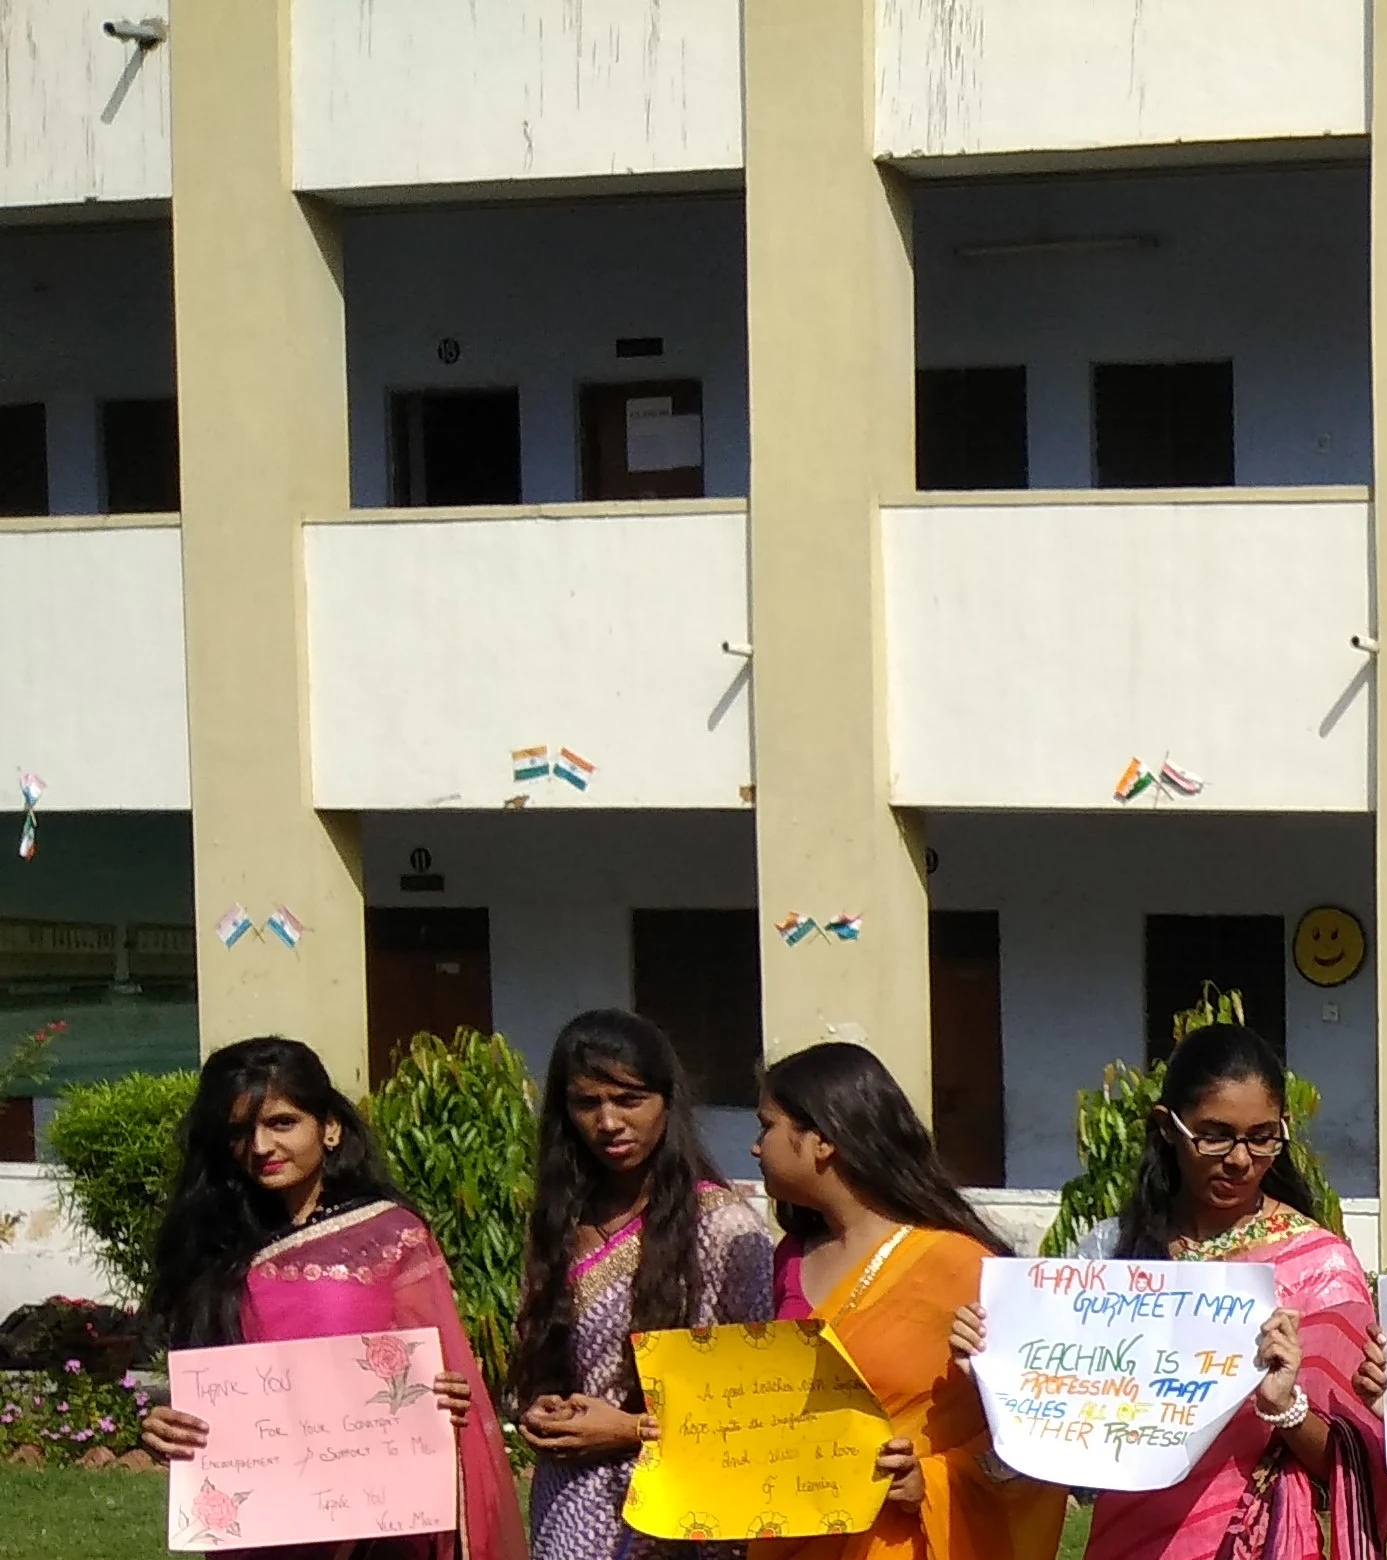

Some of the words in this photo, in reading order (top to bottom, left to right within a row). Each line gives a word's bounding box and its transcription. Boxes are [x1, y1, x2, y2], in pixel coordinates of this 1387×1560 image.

[1028, 1260, 1107, 1295] THANK
[1127, 1264, 1165, 1292] YOU
[1073, 1290, 1192, 1326] GURMEET
[1193, 1294, 1255, 1325] MAM
[1018, 1334, 1144, 1376] TEACHING
[1154, 1350, 1180, 1374] IS
[1194, 1350, 1244, 1377] THE
[1019, 1370, 1140, 1402] PROFESSING
[1149, 1377, 1219, 1404] THAT
[995, 1392, 1068, 1419] ACHES
[1160, 1402, 1199, 1426] THE
[1014, 1415, 1095, 1450] THER
